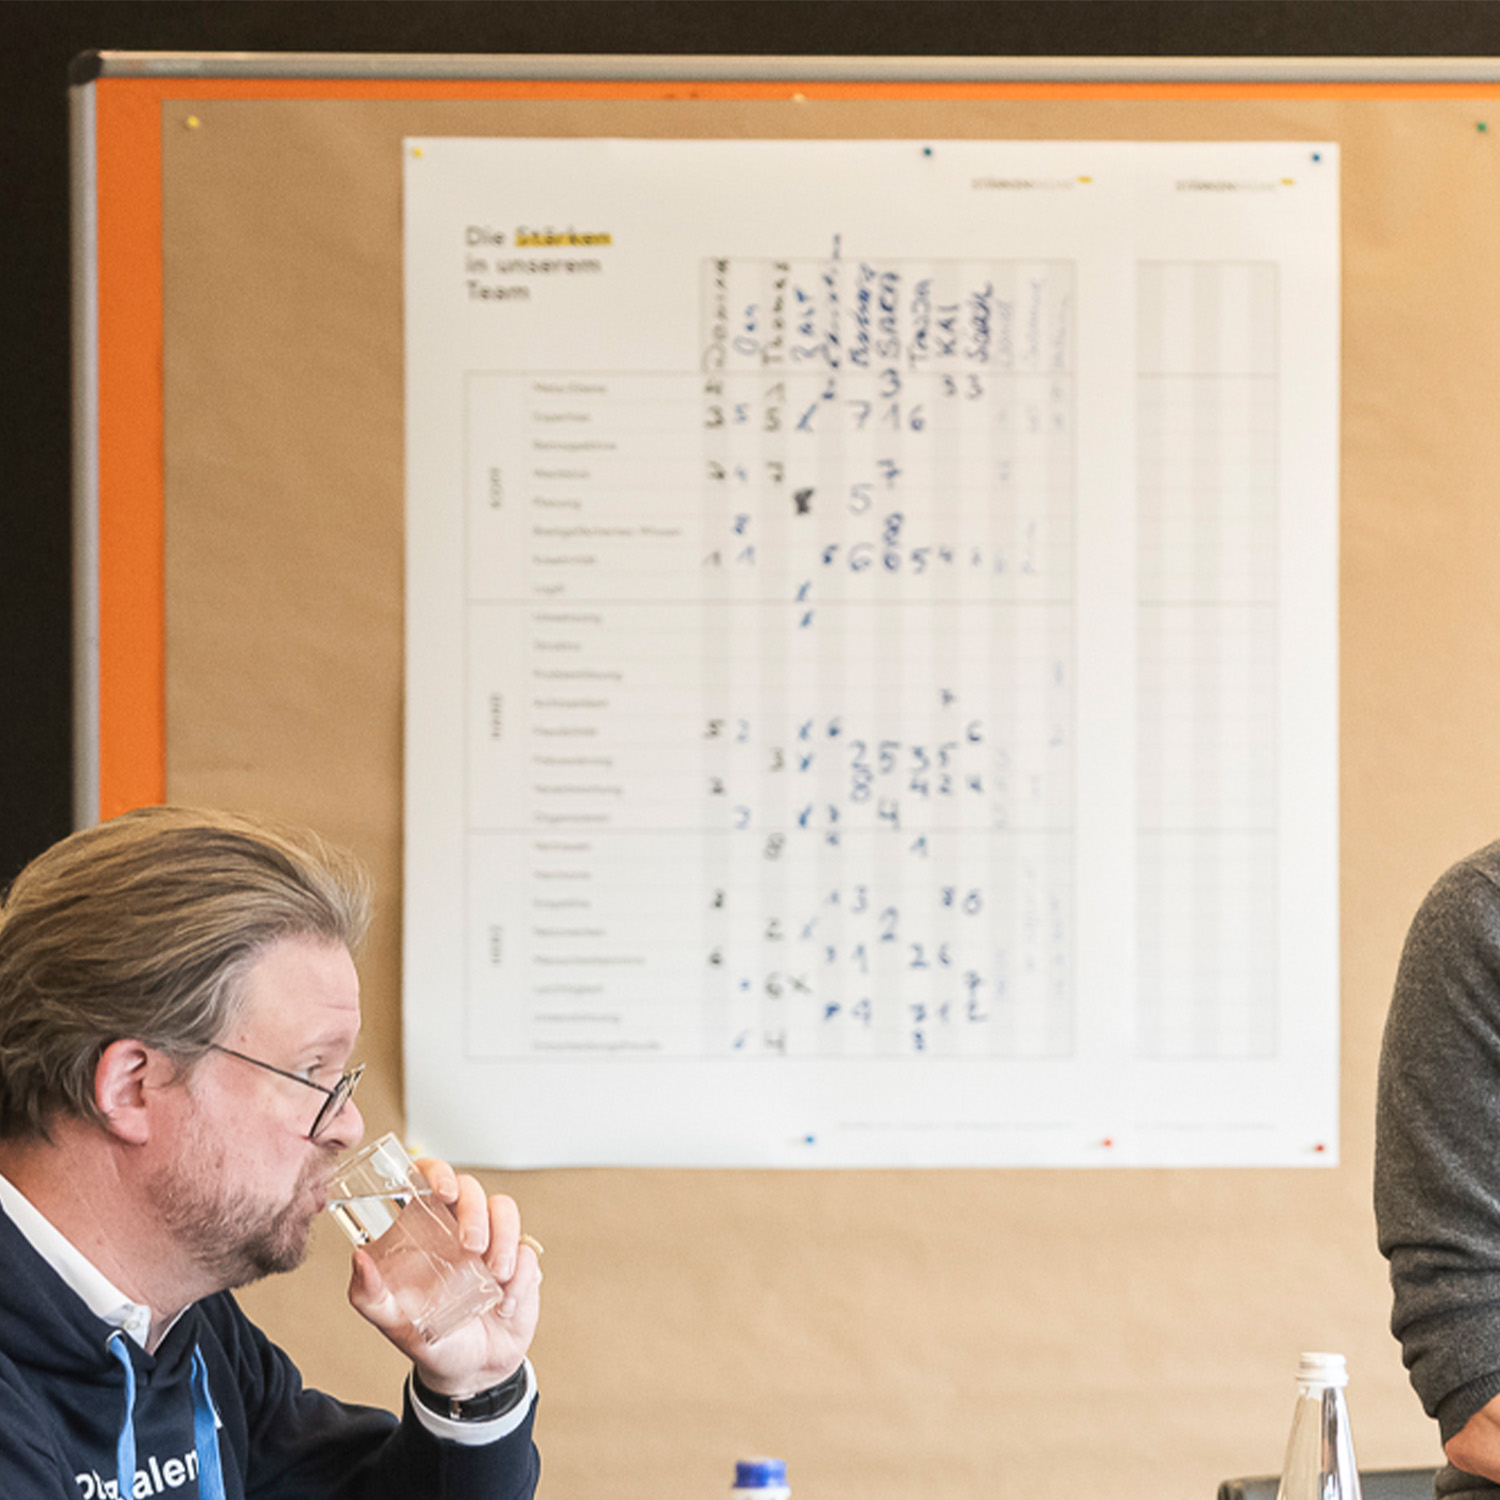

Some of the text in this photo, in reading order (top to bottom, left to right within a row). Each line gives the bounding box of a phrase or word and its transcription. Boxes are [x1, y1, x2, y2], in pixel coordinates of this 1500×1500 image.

[466, 224, 612, 247] Die Stärken
[466, 253, 602, 273] in unserem
[466, 279, 530, 299] Team
